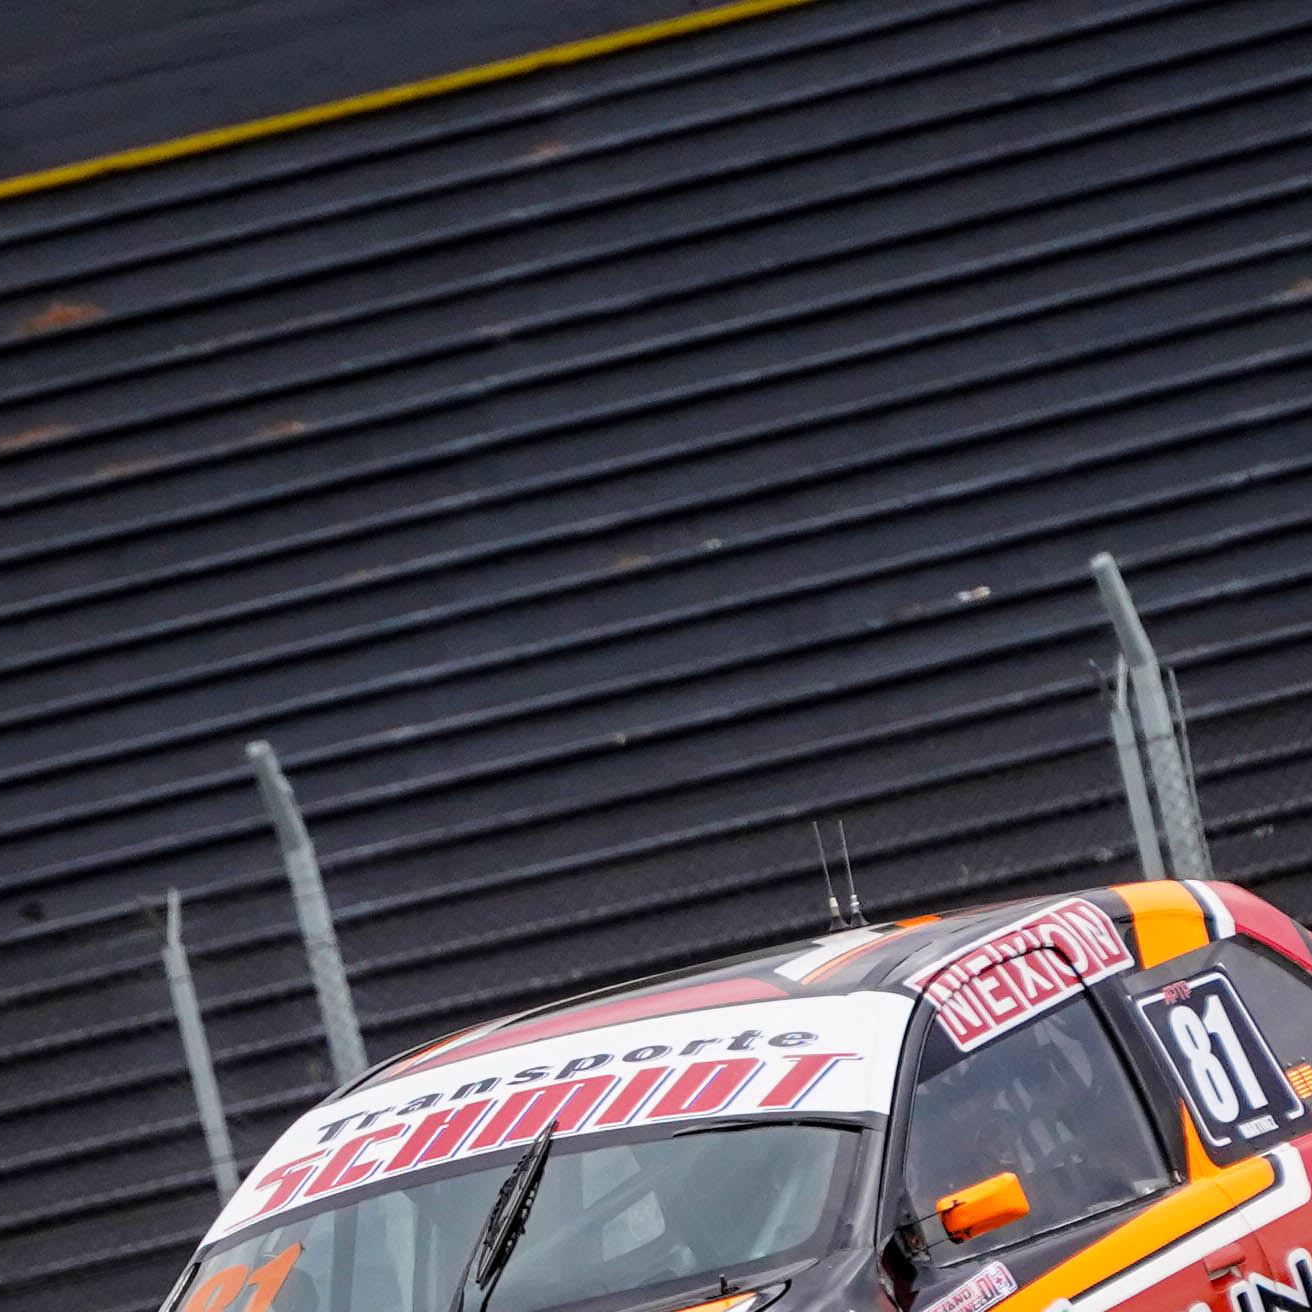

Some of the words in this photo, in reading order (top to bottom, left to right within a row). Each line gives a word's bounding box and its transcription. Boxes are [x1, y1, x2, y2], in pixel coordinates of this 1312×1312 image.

[319, 1028, 820, 1145] Transporte
[1169, 994, 1270, 1124] 81
[232, 1053, 865, 1233] SCHMIDT
